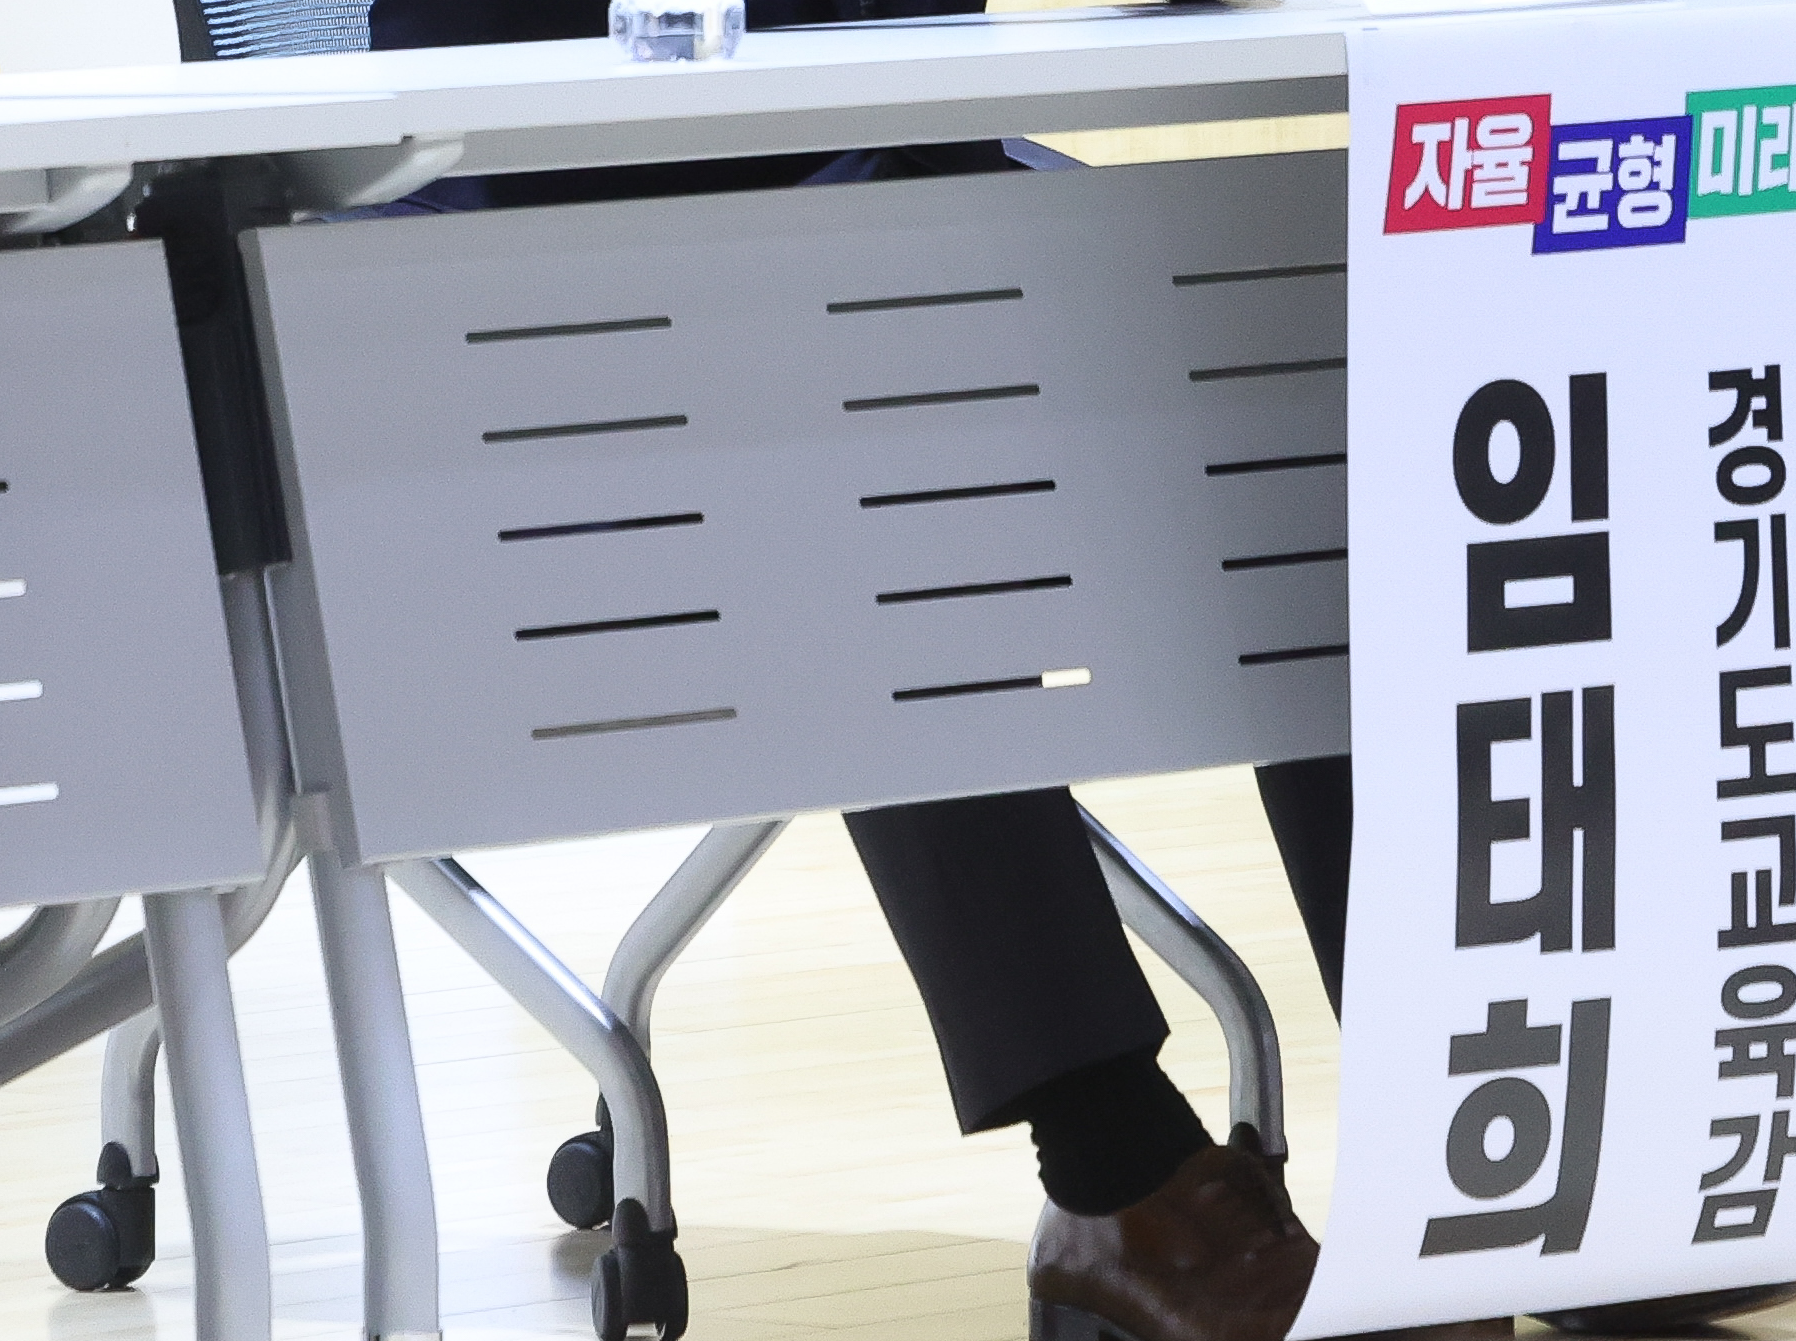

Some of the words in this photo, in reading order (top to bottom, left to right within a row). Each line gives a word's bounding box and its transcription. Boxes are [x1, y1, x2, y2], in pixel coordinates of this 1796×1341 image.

[1403, 112, 1534, 210] 자율
[1551, 132, 1677, 231] 균형
[1418, 371, 1617, 1258] 임태희
